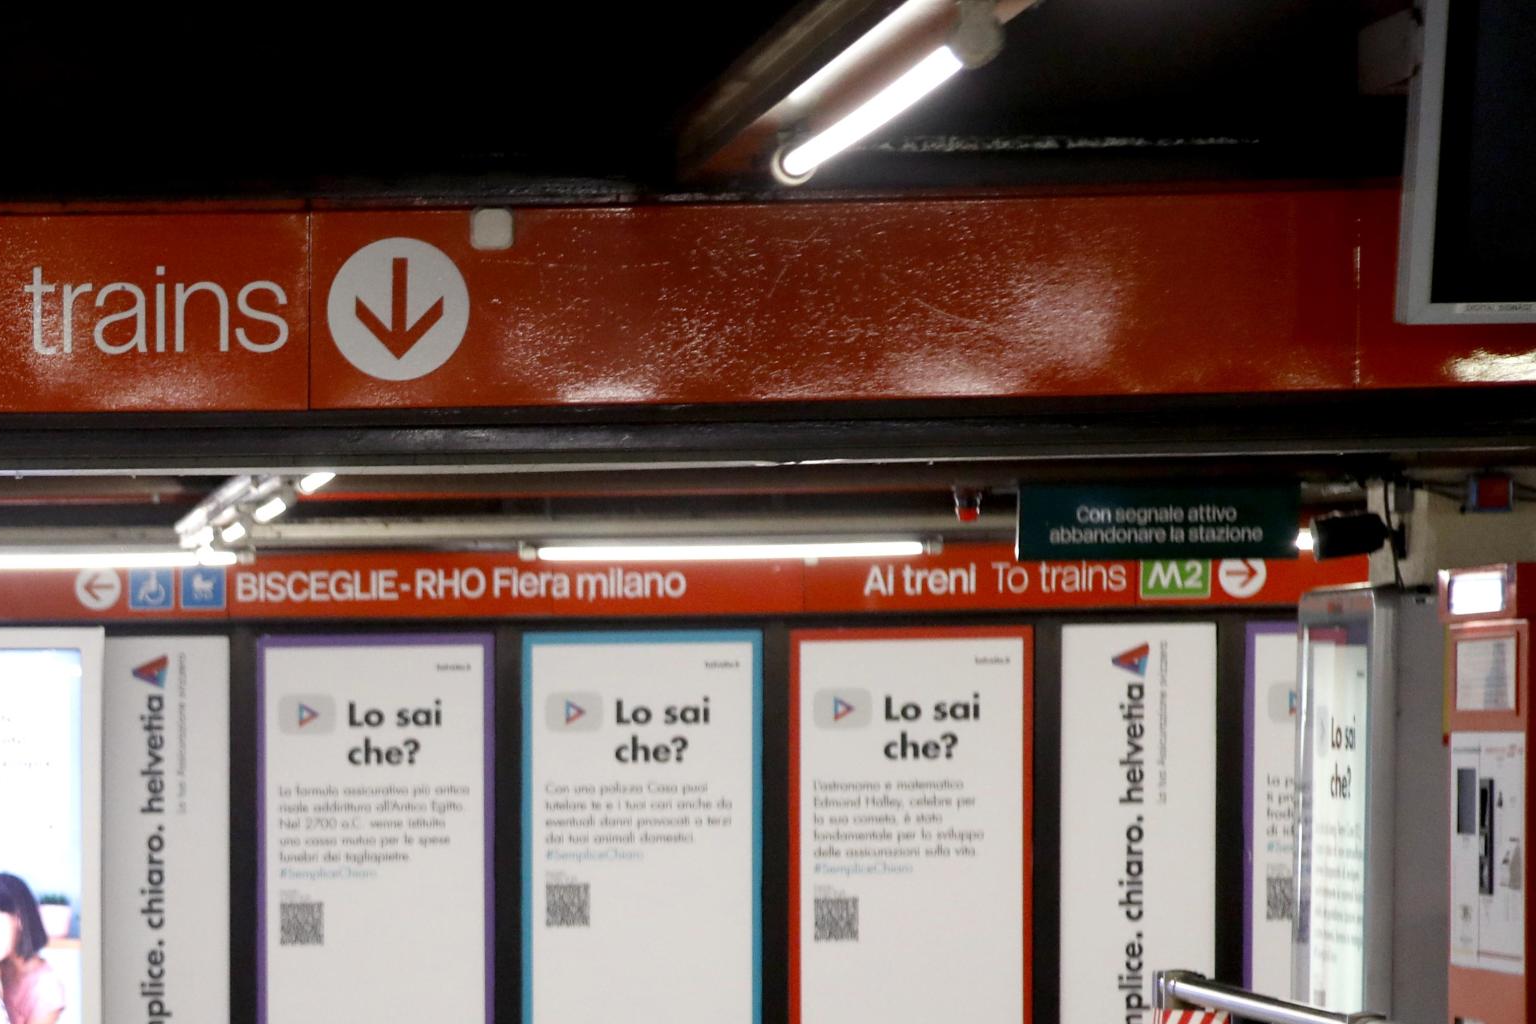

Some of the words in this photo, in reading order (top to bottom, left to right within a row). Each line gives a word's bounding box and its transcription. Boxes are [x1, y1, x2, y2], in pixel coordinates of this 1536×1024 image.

[24, 266, 287, 355] trains
[1077, 506, 1111, 523] Con
[1116, 505, 1183, 524] segnale
[1188, 505, 1237, 522] attivo
[1050, 526, 1164, 544] abbandonare
[1171, 525, 1184, 542] la
[1190, 525, 1262, 542] stazione
[493, 566, 570, 600] Fiera
[578, 566, 686, 598] milano
[864, 564, 894, 596] Ai
[903, 562, 976, 595] treni
[992, 562, 1028, 592] To
[1040, 561, 1127, 593] trains
[1147, 562, 1203, 588] M2
[348, 702, 384, 727] Lo
[396, 699, 442, 726] sai
[616, 699, 652, 725] Lo
[664, 697, 710, 724] sai
[885, 696, 921, 720] Lo
[934, 692, 980, 720] sai
[884, 731, 958, 760] che?
[1119, 682, 1144, 805] helvetia
[1331, 717, 1341, 749] Lo
[1344, 717, 1356, 749] sai
[140, 694, 165, 813] helvetia
[348, 737, 420, 765] che?
[615, 735, 688, 763] che?
[296, 786, 339, 796] formula
[1331, 763, 1352, 797] che?
[678, 798, 712, 809] anche
[814, 797, 861, 807] Edmond
[957, 798, 976, 810] per
[306, 818, 337, 829] 2700
[594, 831, 635, 842] animali
[897, 832, 916, 843] per
[814, 847, 841, 858] delle
[140, 825, 165, 930] chiaro.
[1119, 815, 1144, 921] chiaro.
